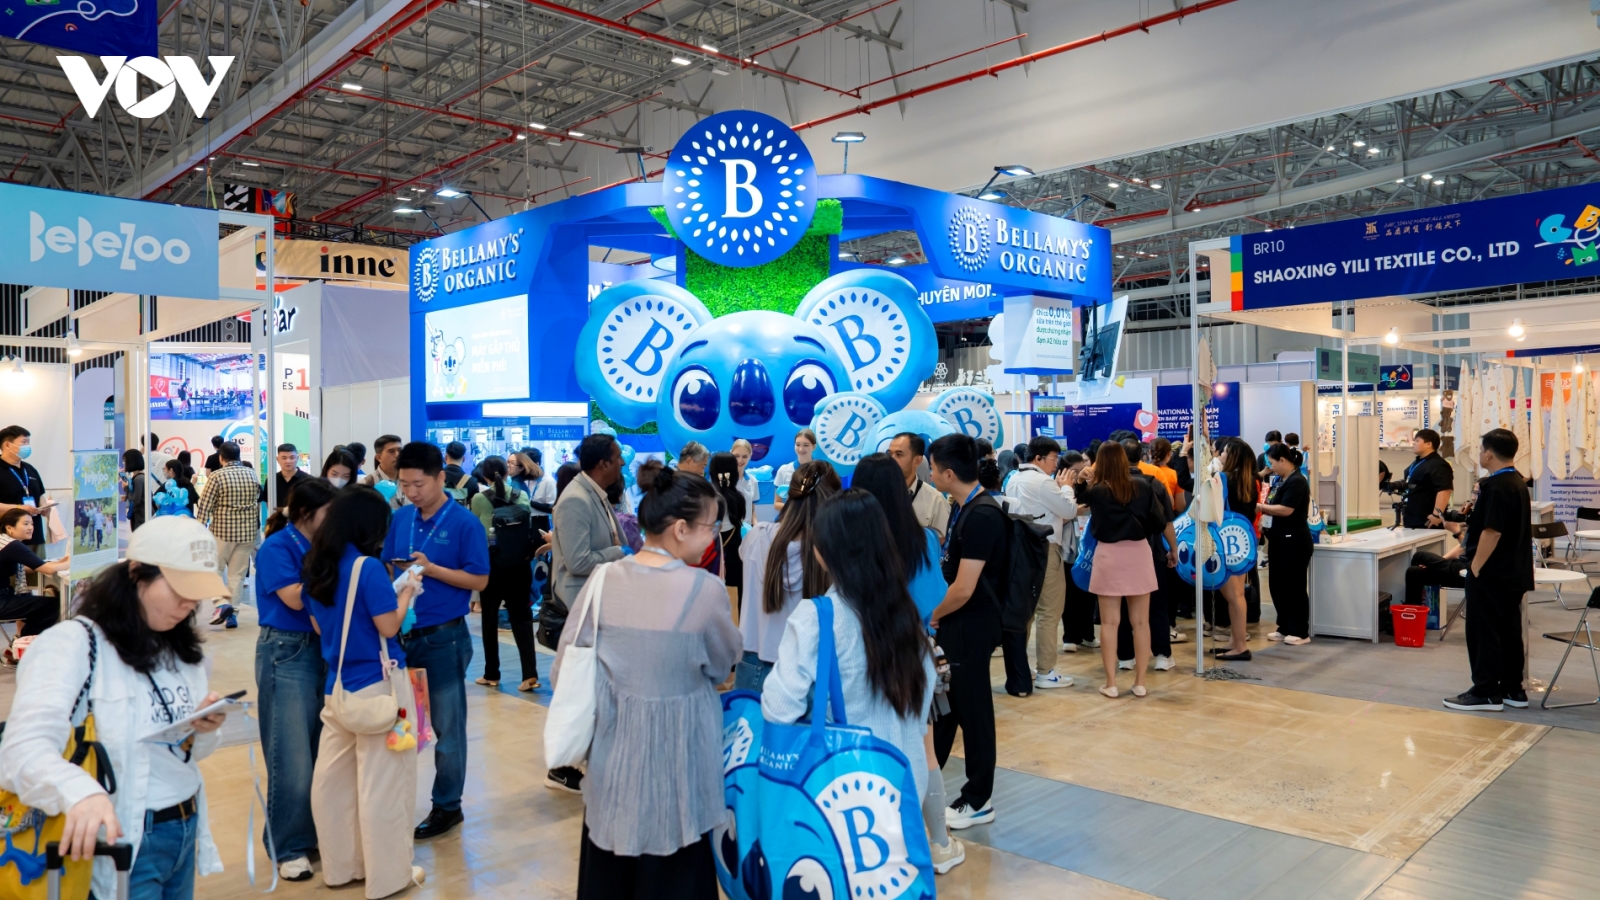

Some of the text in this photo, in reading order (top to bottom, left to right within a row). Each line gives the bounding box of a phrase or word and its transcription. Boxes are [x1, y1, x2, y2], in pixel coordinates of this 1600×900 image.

[720, 159, 763, 217] B
[442, 233, 519, 271] BELLAMY'S
[964, 223, 979, 253] B
[996, 218, 1090, 260] BELLAMY'S
[1253, 240, 1285, 255] BR10
[320, 246, 395, 278] inne
[422, 262, 432, 288] B
[444, 259, 516, 293] ORGANIC
[1000, 251, 1086, 283] ORGANIC
[1253, 241, 1520, 284] SHAOXING YILI TEXTILE CO., LTD
[1049, 306, 1071, 319] 0,01%
[621, 317, 674, 376] B
[828, 314, 881, 372] B
[296, 368, 309, 390] 1
[833, 411, 867, 449] B
[952, 408, 983, 439] B
[1226, 535, 1240, 556] B
[760, 755, 797, 770] RGANIC
[837, 805, 890, 874] B
